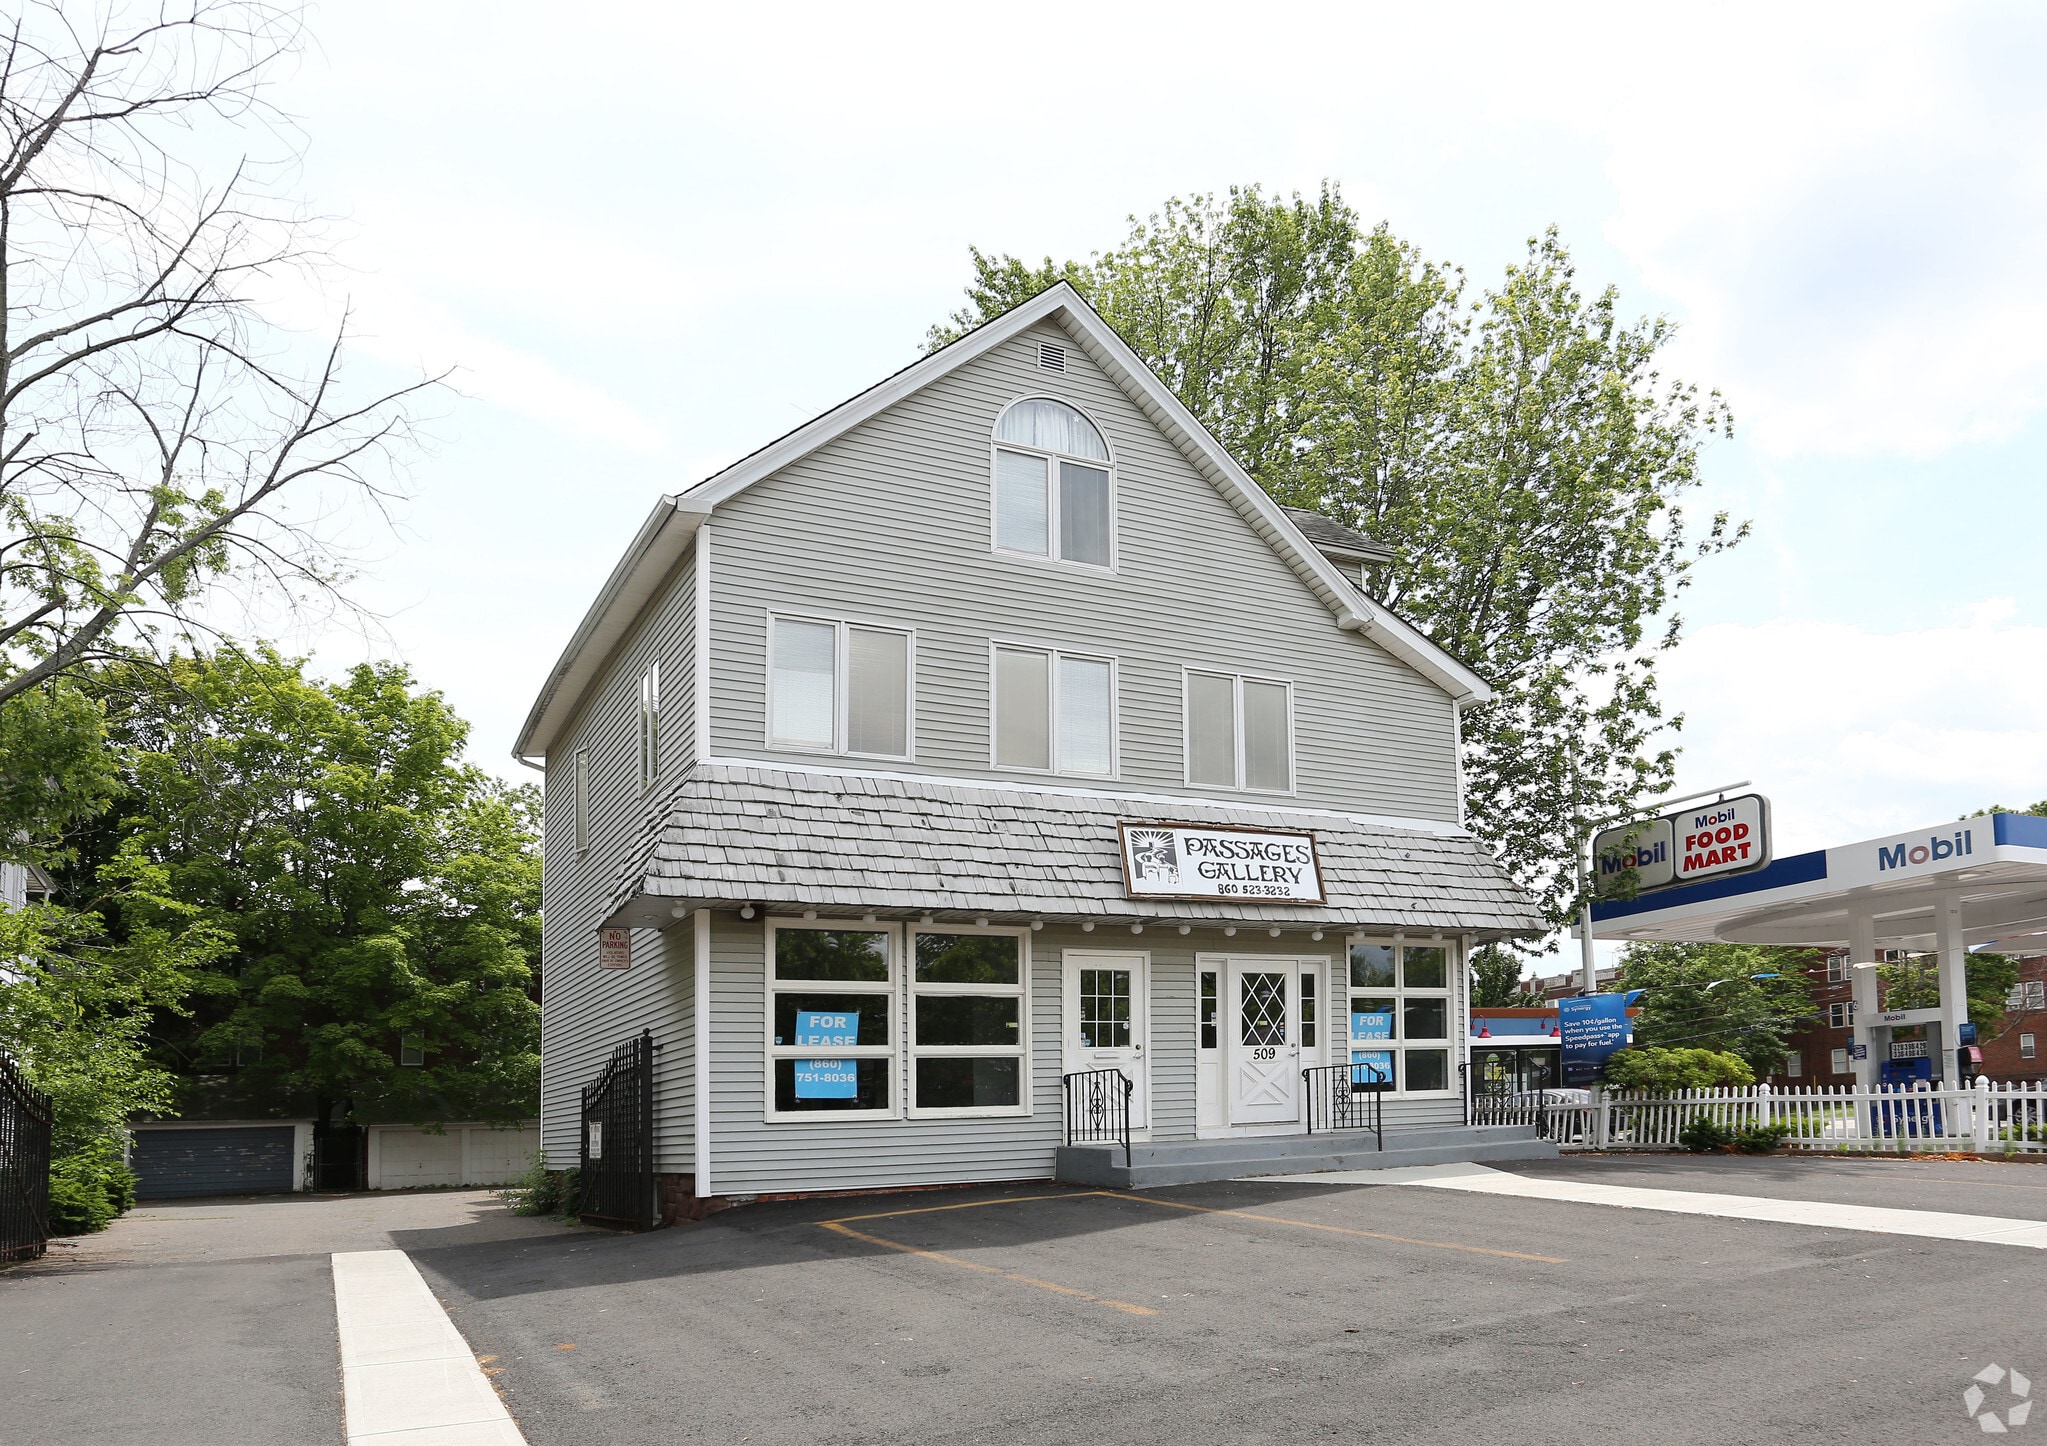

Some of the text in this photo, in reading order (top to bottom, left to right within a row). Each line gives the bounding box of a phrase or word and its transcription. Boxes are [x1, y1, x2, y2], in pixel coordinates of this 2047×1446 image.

[1694, 807, 1735, 829] Mobil
[1685, 822, 1749, 852] FOOD
[1184, 836, 1311, 865] PASSAGES
[1878, 829, 1972, 871] Mobil
[1601, 840, 1666, 876] Mobil
[1682, 841, 1752, 873] MART
[1197, 860, 1304, 885] GALLERY
[1217, 883, 1238, 895] 860
[609, 932, 621, 940] NO
[602, 941, 628, 949] PARKING
[809, 1015, 847, 1029] FOR
[1359, 1016, 1384, 1026] FOR
[1884, 1013, 1906, 1022] Mobil
[797, 1035, 856, 1046] LEASE
[1253, 1047, 1276, 1060] 509
[1358, 1051, 1380, 1060] (860)
[809, 1059, 842, 1071] (860)
[796, 1073, 855, 1083] 751-8036
